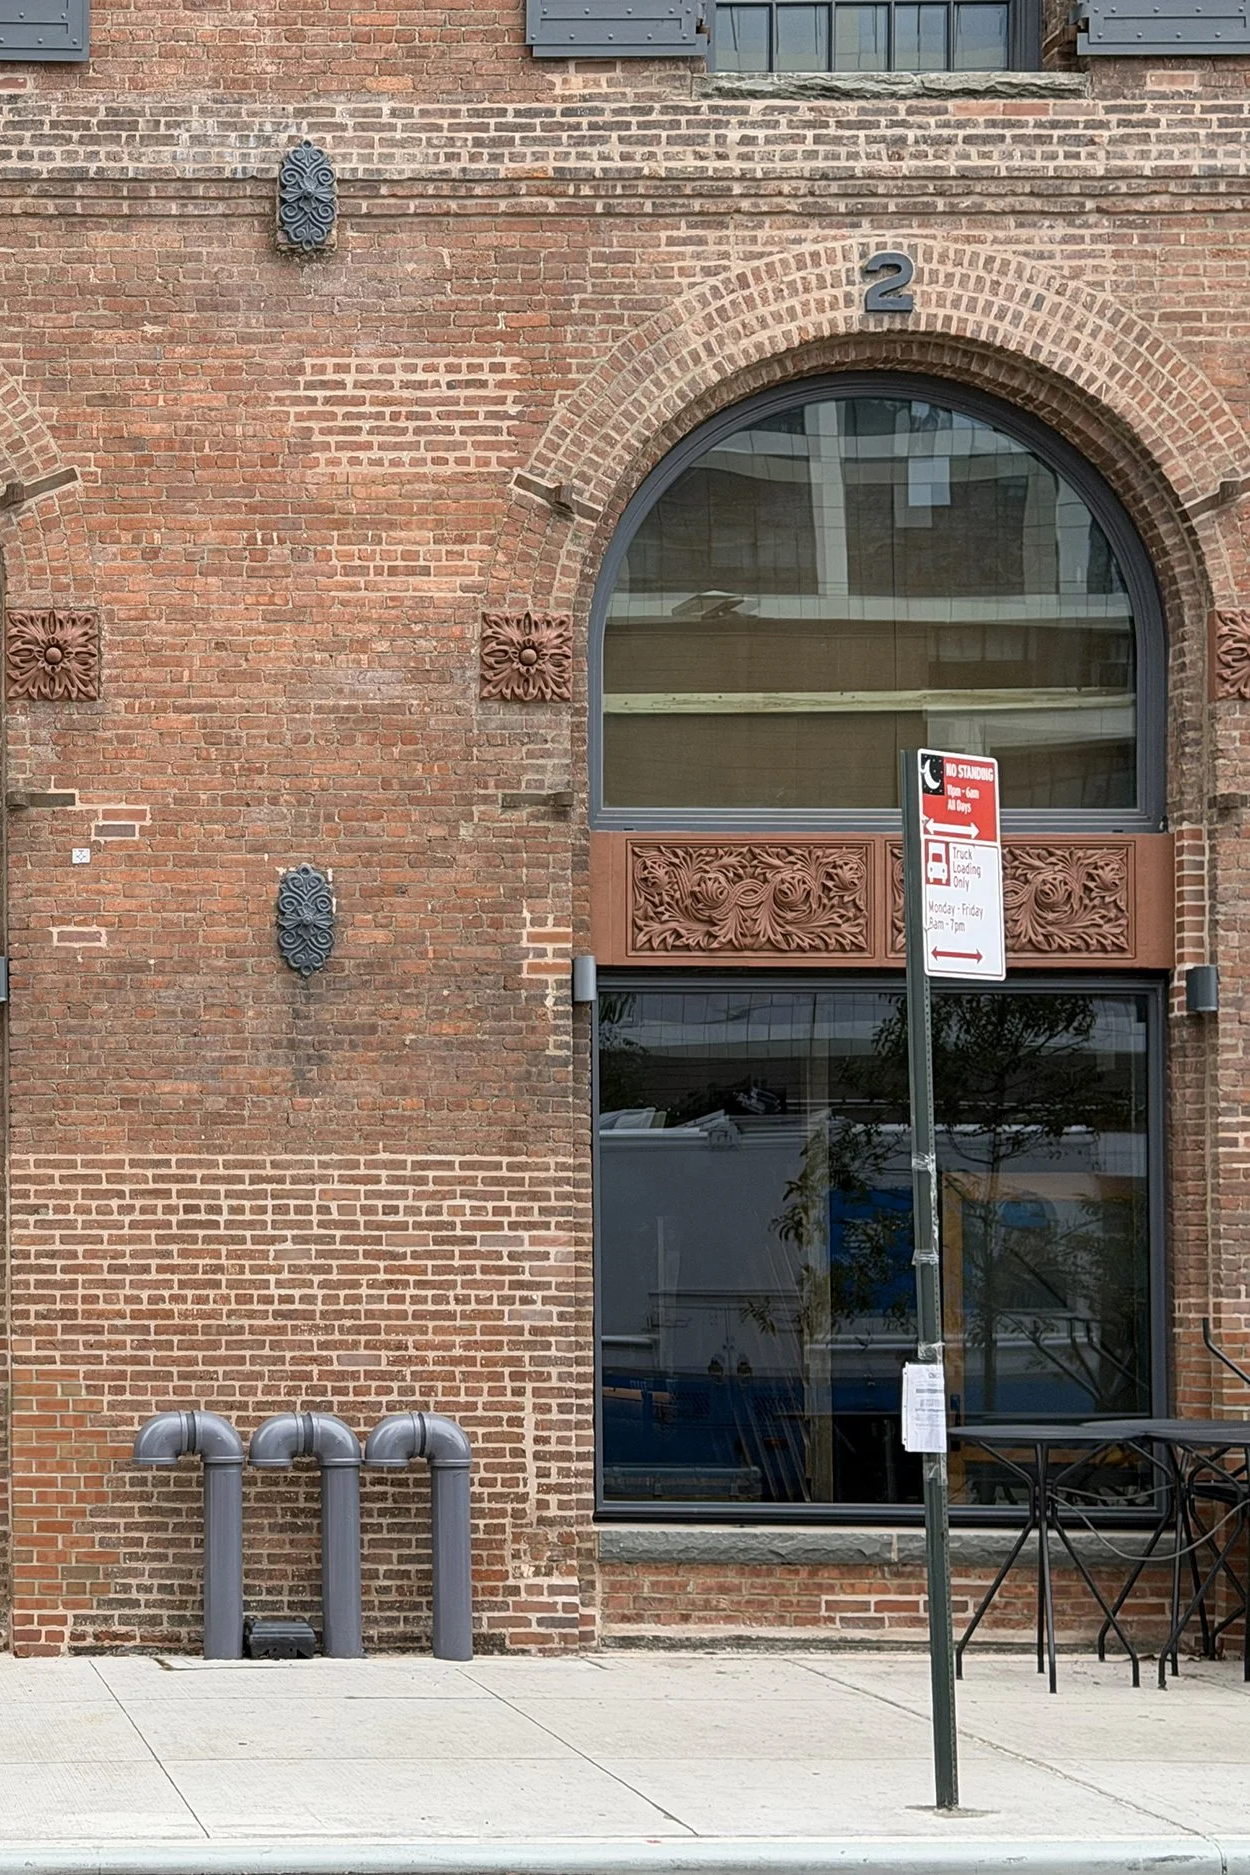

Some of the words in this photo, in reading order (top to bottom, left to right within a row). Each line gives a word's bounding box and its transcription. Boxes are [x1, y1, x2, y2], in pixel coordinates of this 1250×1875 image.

[864, 250, 914, 312] 2
[946, 763, 957, 777] NO
[958, 765, 993, 781] STANDING
[966, 787, 980, 799] 6am
[948, 799, 956, 811] All
[956, 800, 972, 815] Days
[953, 847, 972, 860] Truck
[953, 862, 981, 878] Loading
[953, 876, 969, 892] Only
[929, 901, 955, 916] Monday
[962, 903, 983, 920] Friday
[950, 919, 965, 934] 7pm
